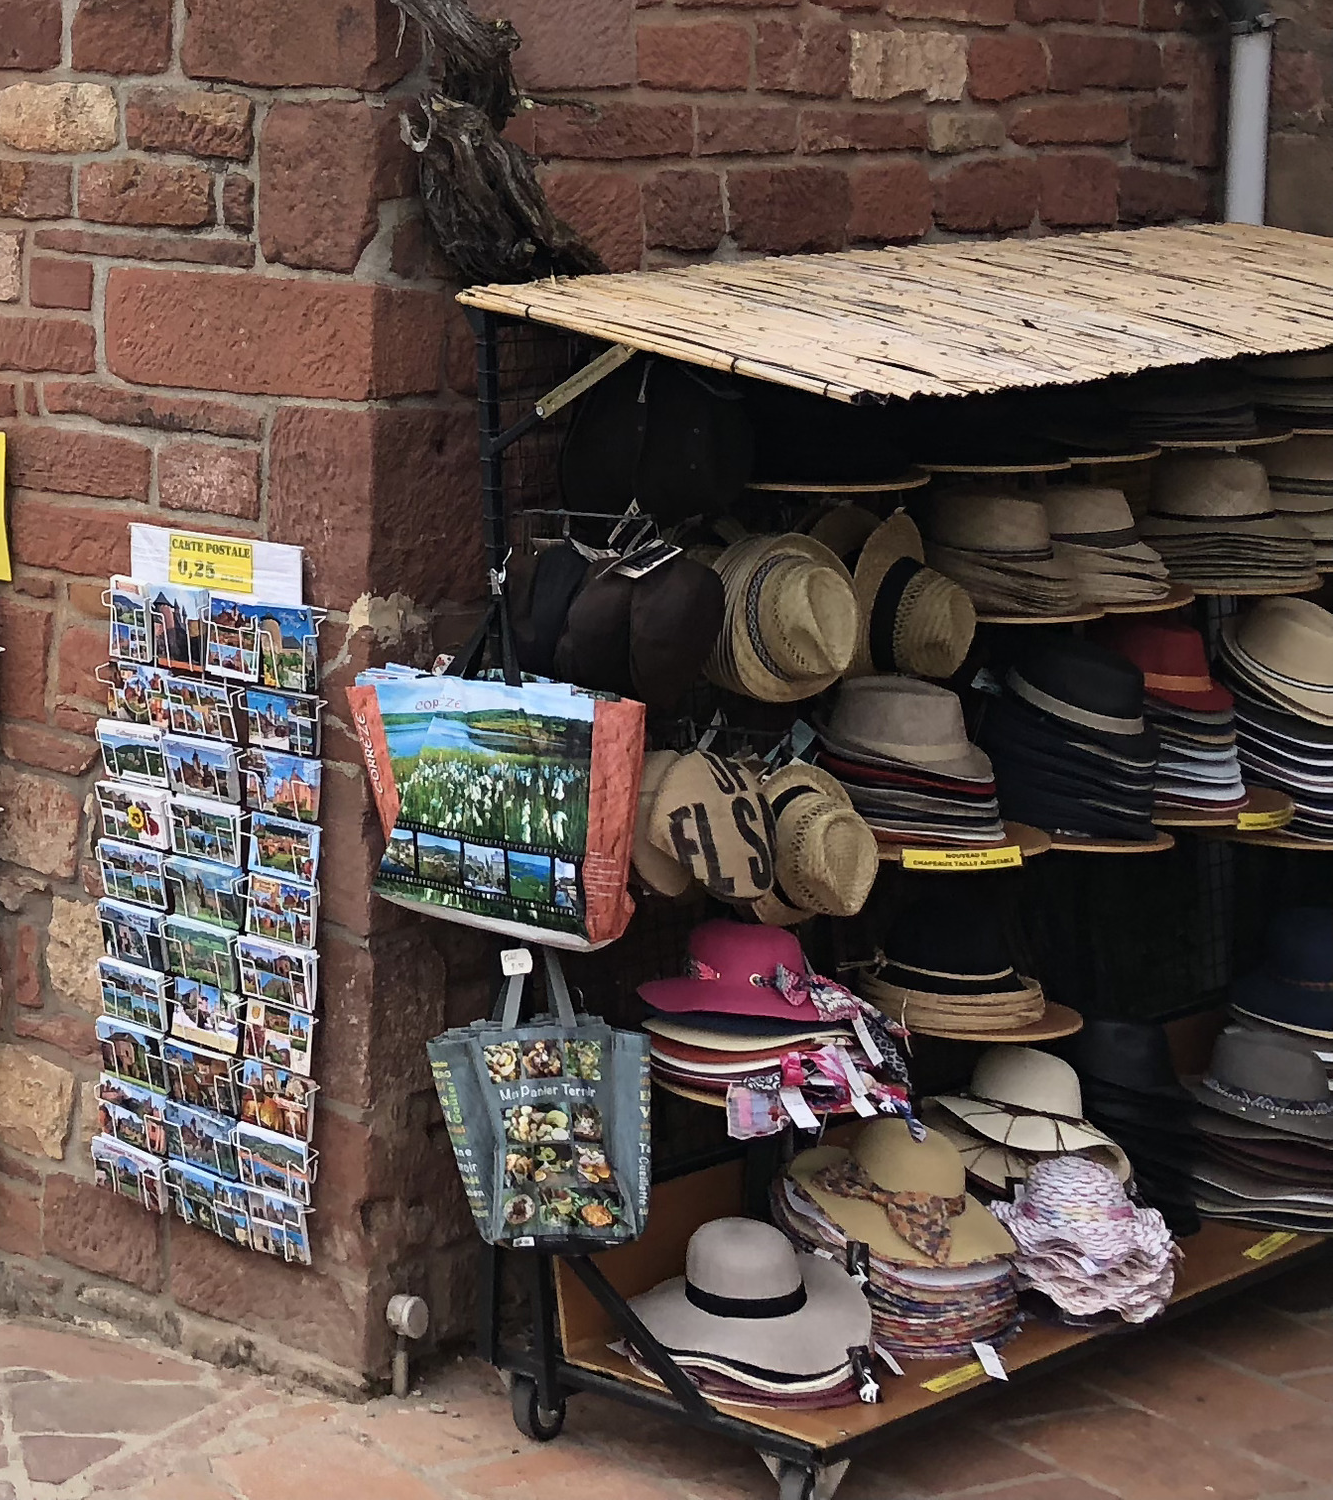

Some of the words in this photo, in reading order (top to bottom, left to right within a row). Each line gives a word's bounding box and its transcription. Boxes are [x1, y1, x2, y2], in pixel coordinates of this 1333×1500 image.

[172, 538, 203, 552] CARTE
[206, 543, 251, 559] POSTALE
[177, 559, 215, 580] 0,25
[521, 1086, 558, 1103] Panier
